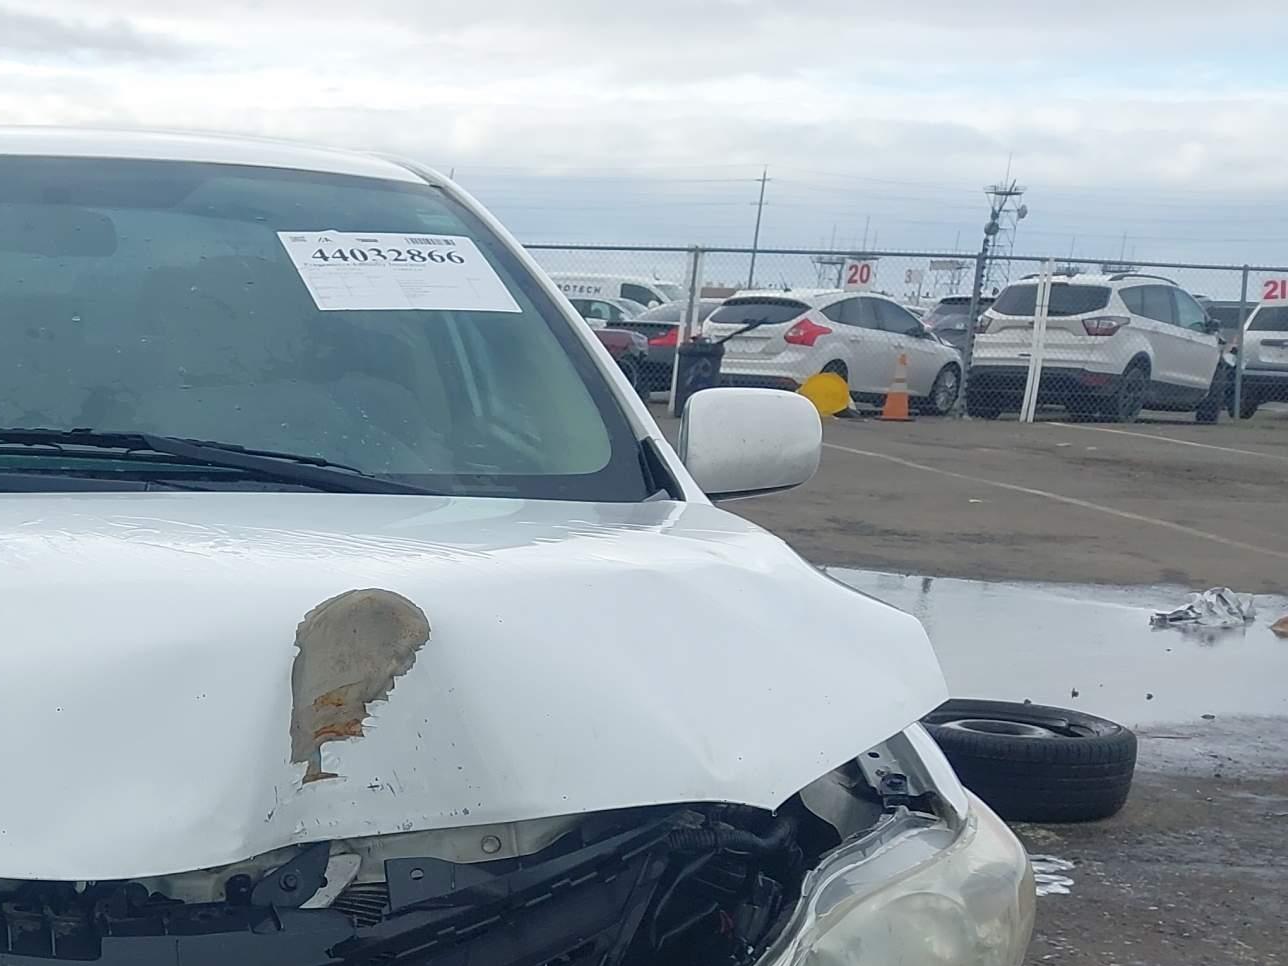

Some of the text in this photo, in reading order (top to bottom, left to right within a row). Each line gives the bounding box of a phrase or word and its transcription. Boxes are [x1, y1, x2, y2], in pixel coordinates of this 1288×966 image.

[311, 247, 465, 265] 44032866
[847, 263, 871, 284] 20
[1263, 279, 1287, 300] 21
